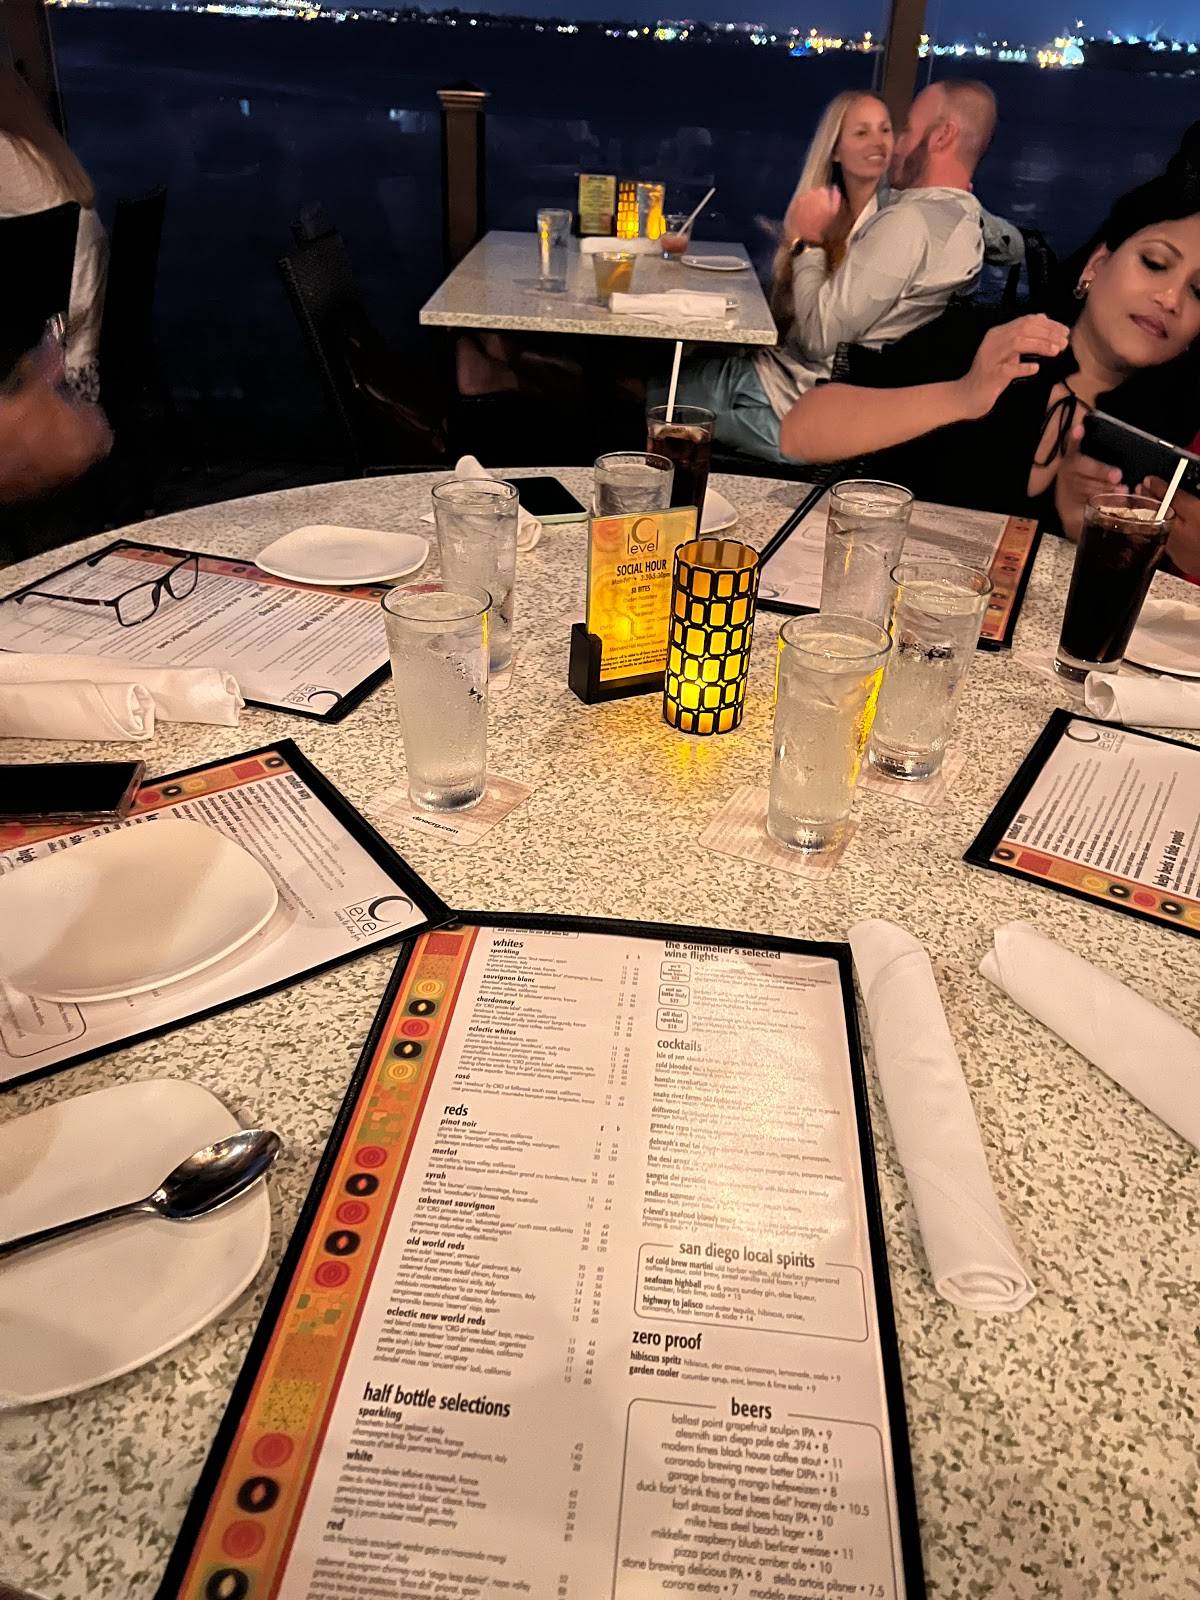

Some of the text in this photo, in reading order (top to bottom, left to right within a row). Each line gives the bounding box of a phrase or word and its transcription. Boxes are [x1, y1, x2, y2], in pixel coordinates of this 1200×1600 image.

[616, 560, 667, 576] SOCIAL HOUR
[638, 585, 651, 593] BITES
[493, 938, 523, 948] whites
[665, 941, 781, 960] the sommelier's selected
[665, 950, 718, 962] wine flights
[477, 995, 515, 1006] chardonnay
[468, 1025, 516, 1035] eclectic whites
[657, 1038, 701, 1051] cocktails
[444, 1103, 468, 1116] reds
[652, 1106, 680, 1114] driftwood
[432, 1147, 457, 1155] merlot
[425, 1171, 446, 1179] syrah
[418, 1196, 495, 1211] cabernet sauvignon
[406, 1236, 464, 1250] old world reds
[646, 1256, 713, 1270] sd cold brew martini
[679, 1243, 815, 1269] san diego local spirits
[644, 1275, 673, 1285] seafoam
[675, 1277, 701, 1290] highball
[723, 1286, 739, 1295] yours
[643, 1294, 703, 1311] highway to jalisco
[386, 1306, 485, 1326] eclectic new world reds
[632, 1331, 702, 1352] zero proof
[630, 1351, 681, 1366] hibiscus spritz
[629, 1365, 679, 1378] garden cooler
[363, 1381, 510, 1417] half bottle selections
[358, 1405, 402, 1421] sparkling
[731, 1397, 771, 1419] beers
[672, 1413, 832, 1440] ballast point grapefruit sculpin IPA 9
[675, 1427, 710, 1440] alesmith
[712, 1434, 727, 1442] san
[730, 1434, 753, 1447] diego
[756, 1437, 774, 1448] pale
[776, 1439, 789, 1449] ale
[822, 1443, 829, 1454] 8
[347, 1448, 373, 1462] white
[661, 1441, 842, 1468] modern times black house coffee stout 11
[664, 1456, 839, 1482] coronado brewing never better DIPA 11
[667, 1471, 699, 1485] garage
[701, 1472, 736, 1488] brewing
[738, 1479, 770, 1492] mango
[830, 1487, 837, 1497] 8
[326, 1518, 345, 1531] red
